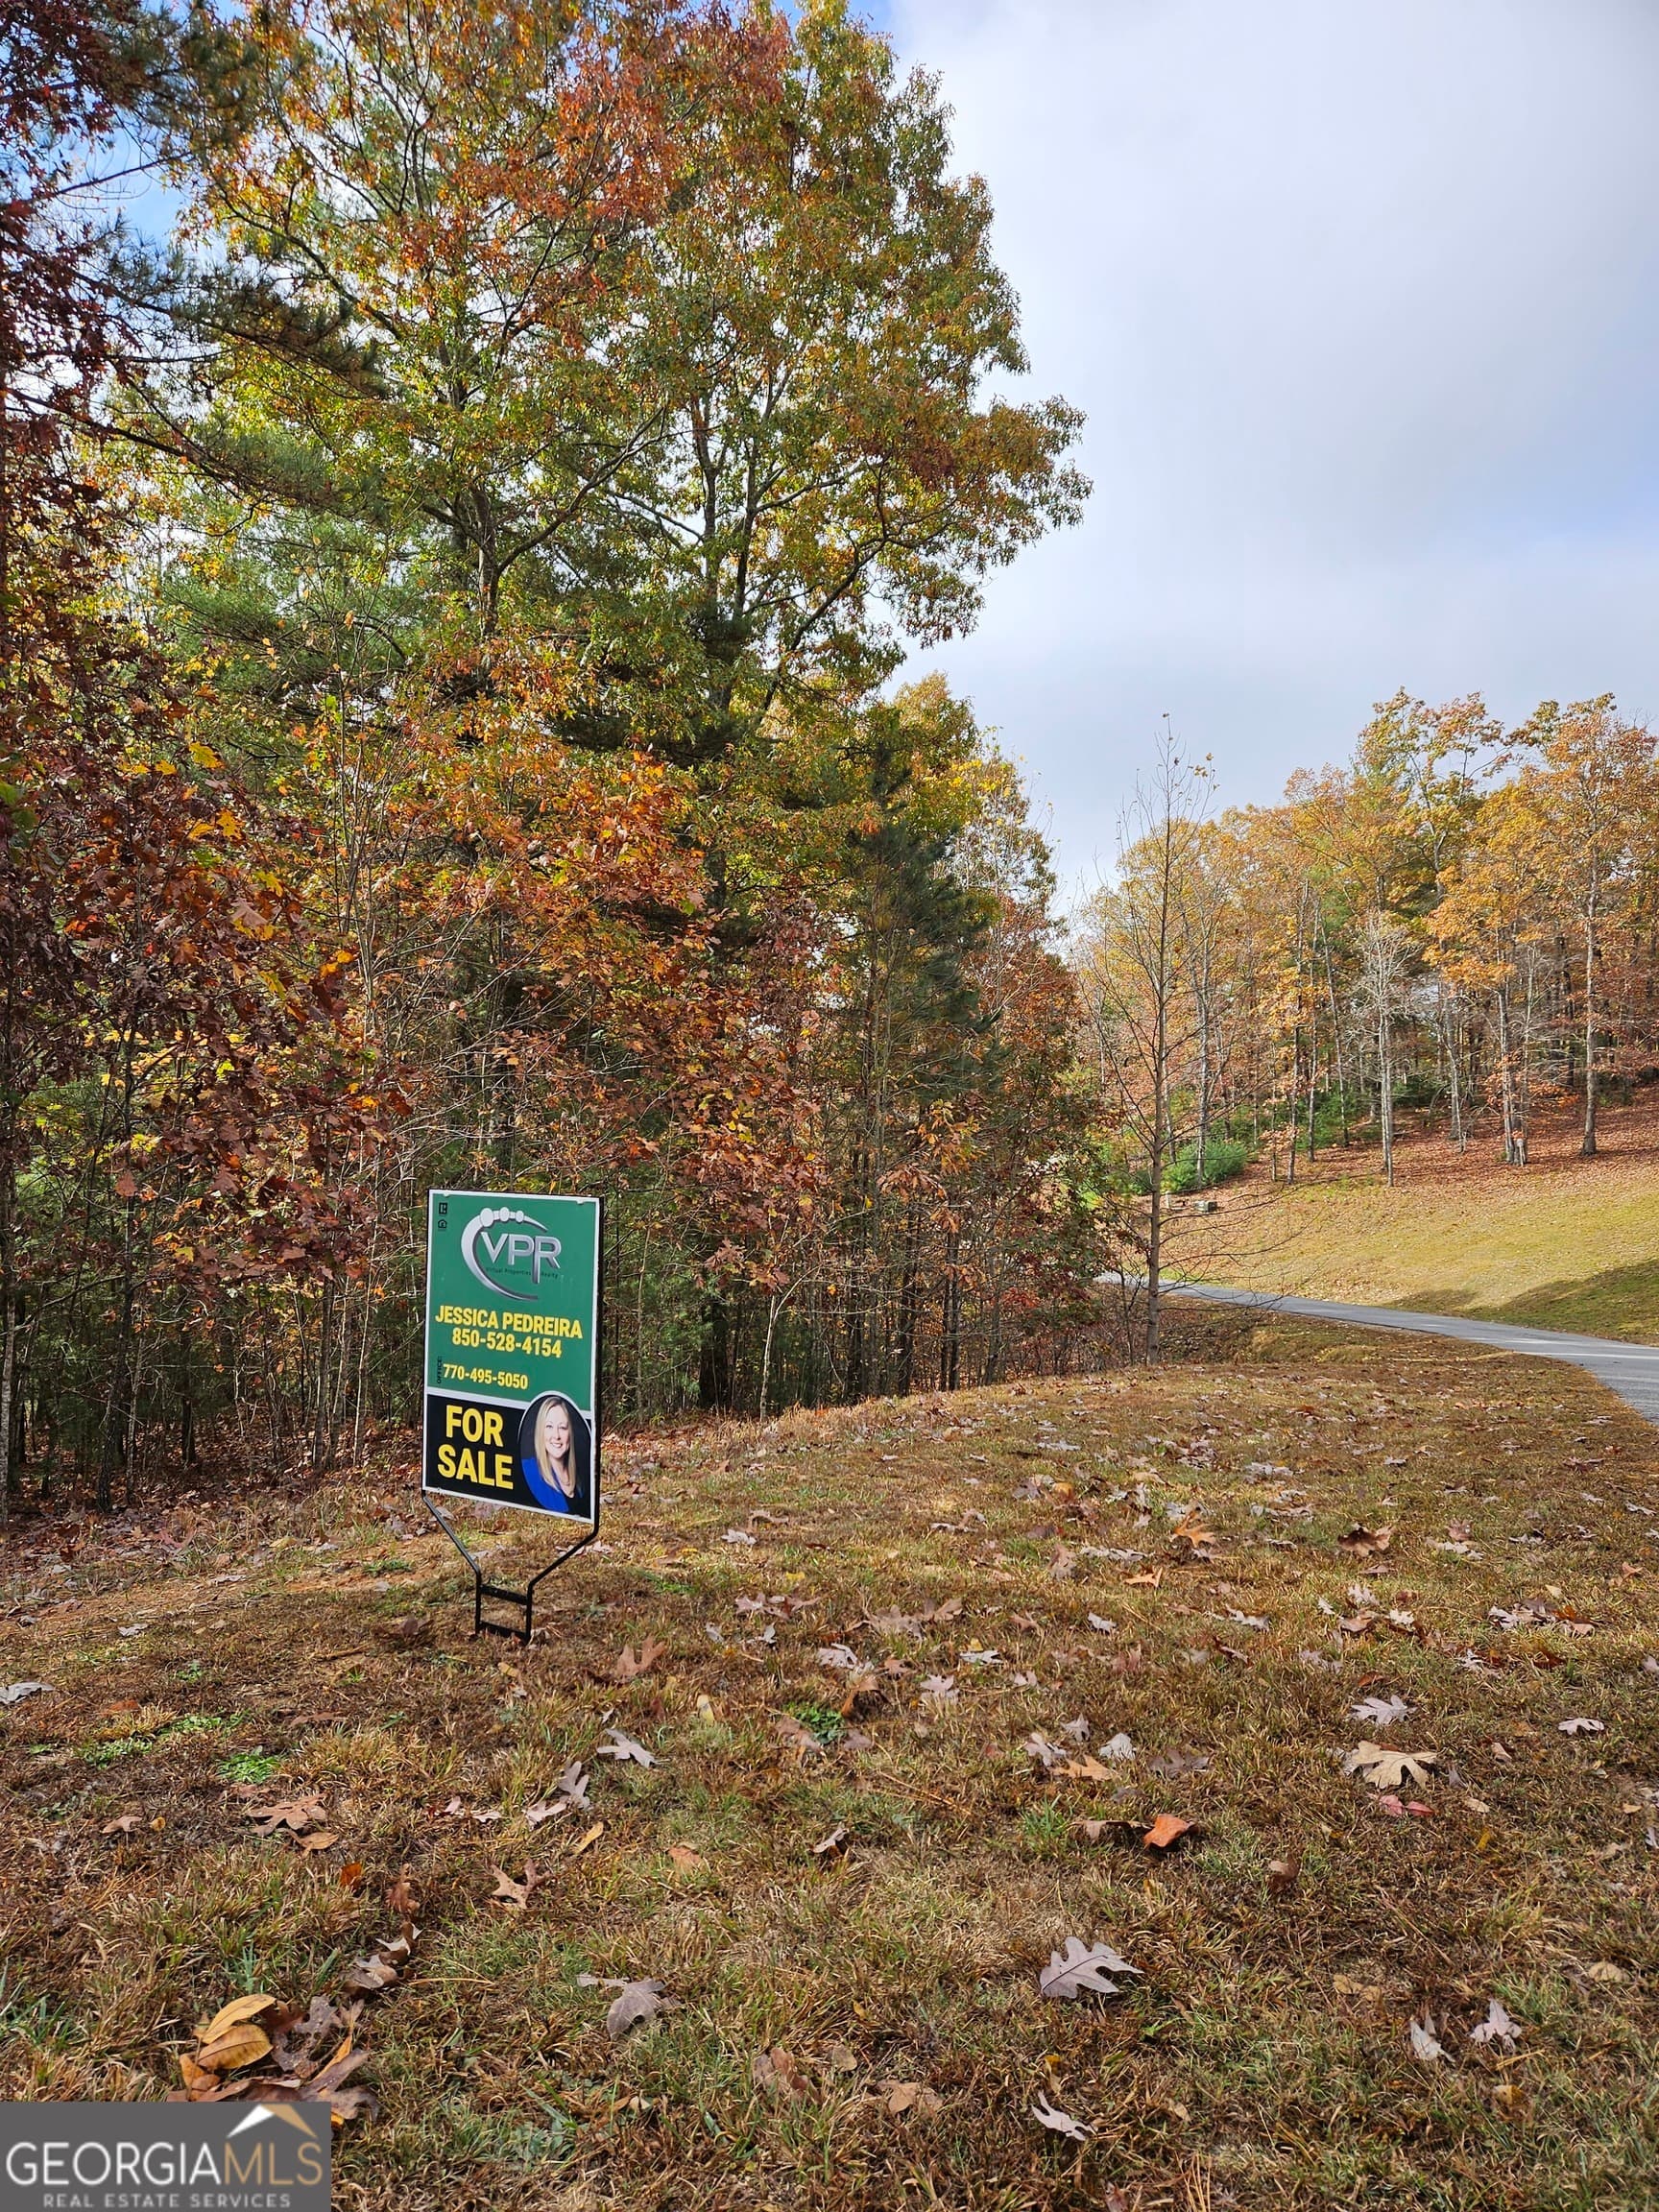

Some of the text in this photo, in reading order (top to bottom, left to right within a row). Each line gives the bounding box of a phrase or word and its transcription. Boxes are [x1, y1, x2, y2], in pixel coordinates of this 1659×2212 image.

[481, 1231, 562, 1284] VPR
[435, 1305, 583, 1339] JESSICA PEDREIRA
[452, 1327, 562, 1358] 850-528-4154
[443, 1363, 528, 1390] 770-495-5050
[445, 1404, 504, 1448] FOR
[437, 1444, 514, 1490] SALE
